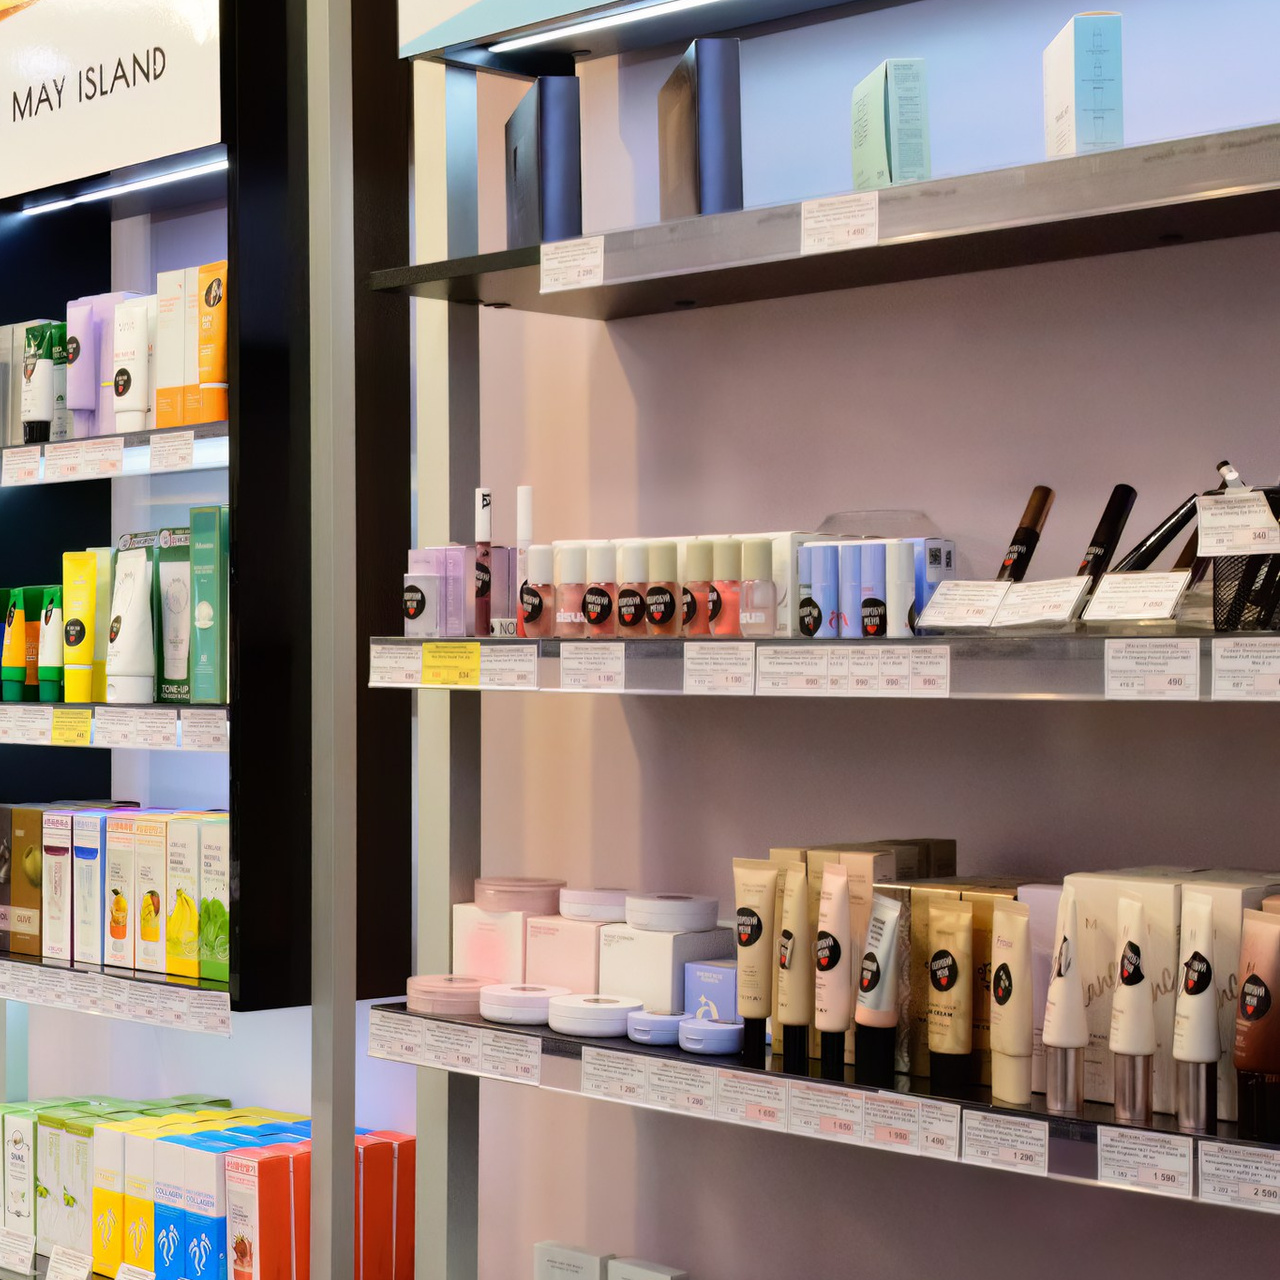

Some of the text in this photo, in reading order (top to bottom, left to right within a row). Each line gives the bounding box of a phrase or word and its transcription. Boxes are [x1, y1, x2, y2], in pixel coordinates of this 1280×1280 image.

[13, 46, 167, 123] MAY ISLAND
[1252, 532, 1267, 540] 340
[500, 622, 517, 635] NO
[1167, 678, 1183, 686] 490
[162, 684, 189, 694] TONE-UP
[16, 915, 32, 924] OLIVE
[10, 1152, 25, 1162] SNAIL
[1019, 1152, 1034, 1162] 290
[1161, 1173, 1176, 1183] 590
[155, 1187, 183, 1199] COLLAGEN
[1261, 1189, 1278, 1199] 590
[186, 1195, 215, 1207] COLLAGEN
